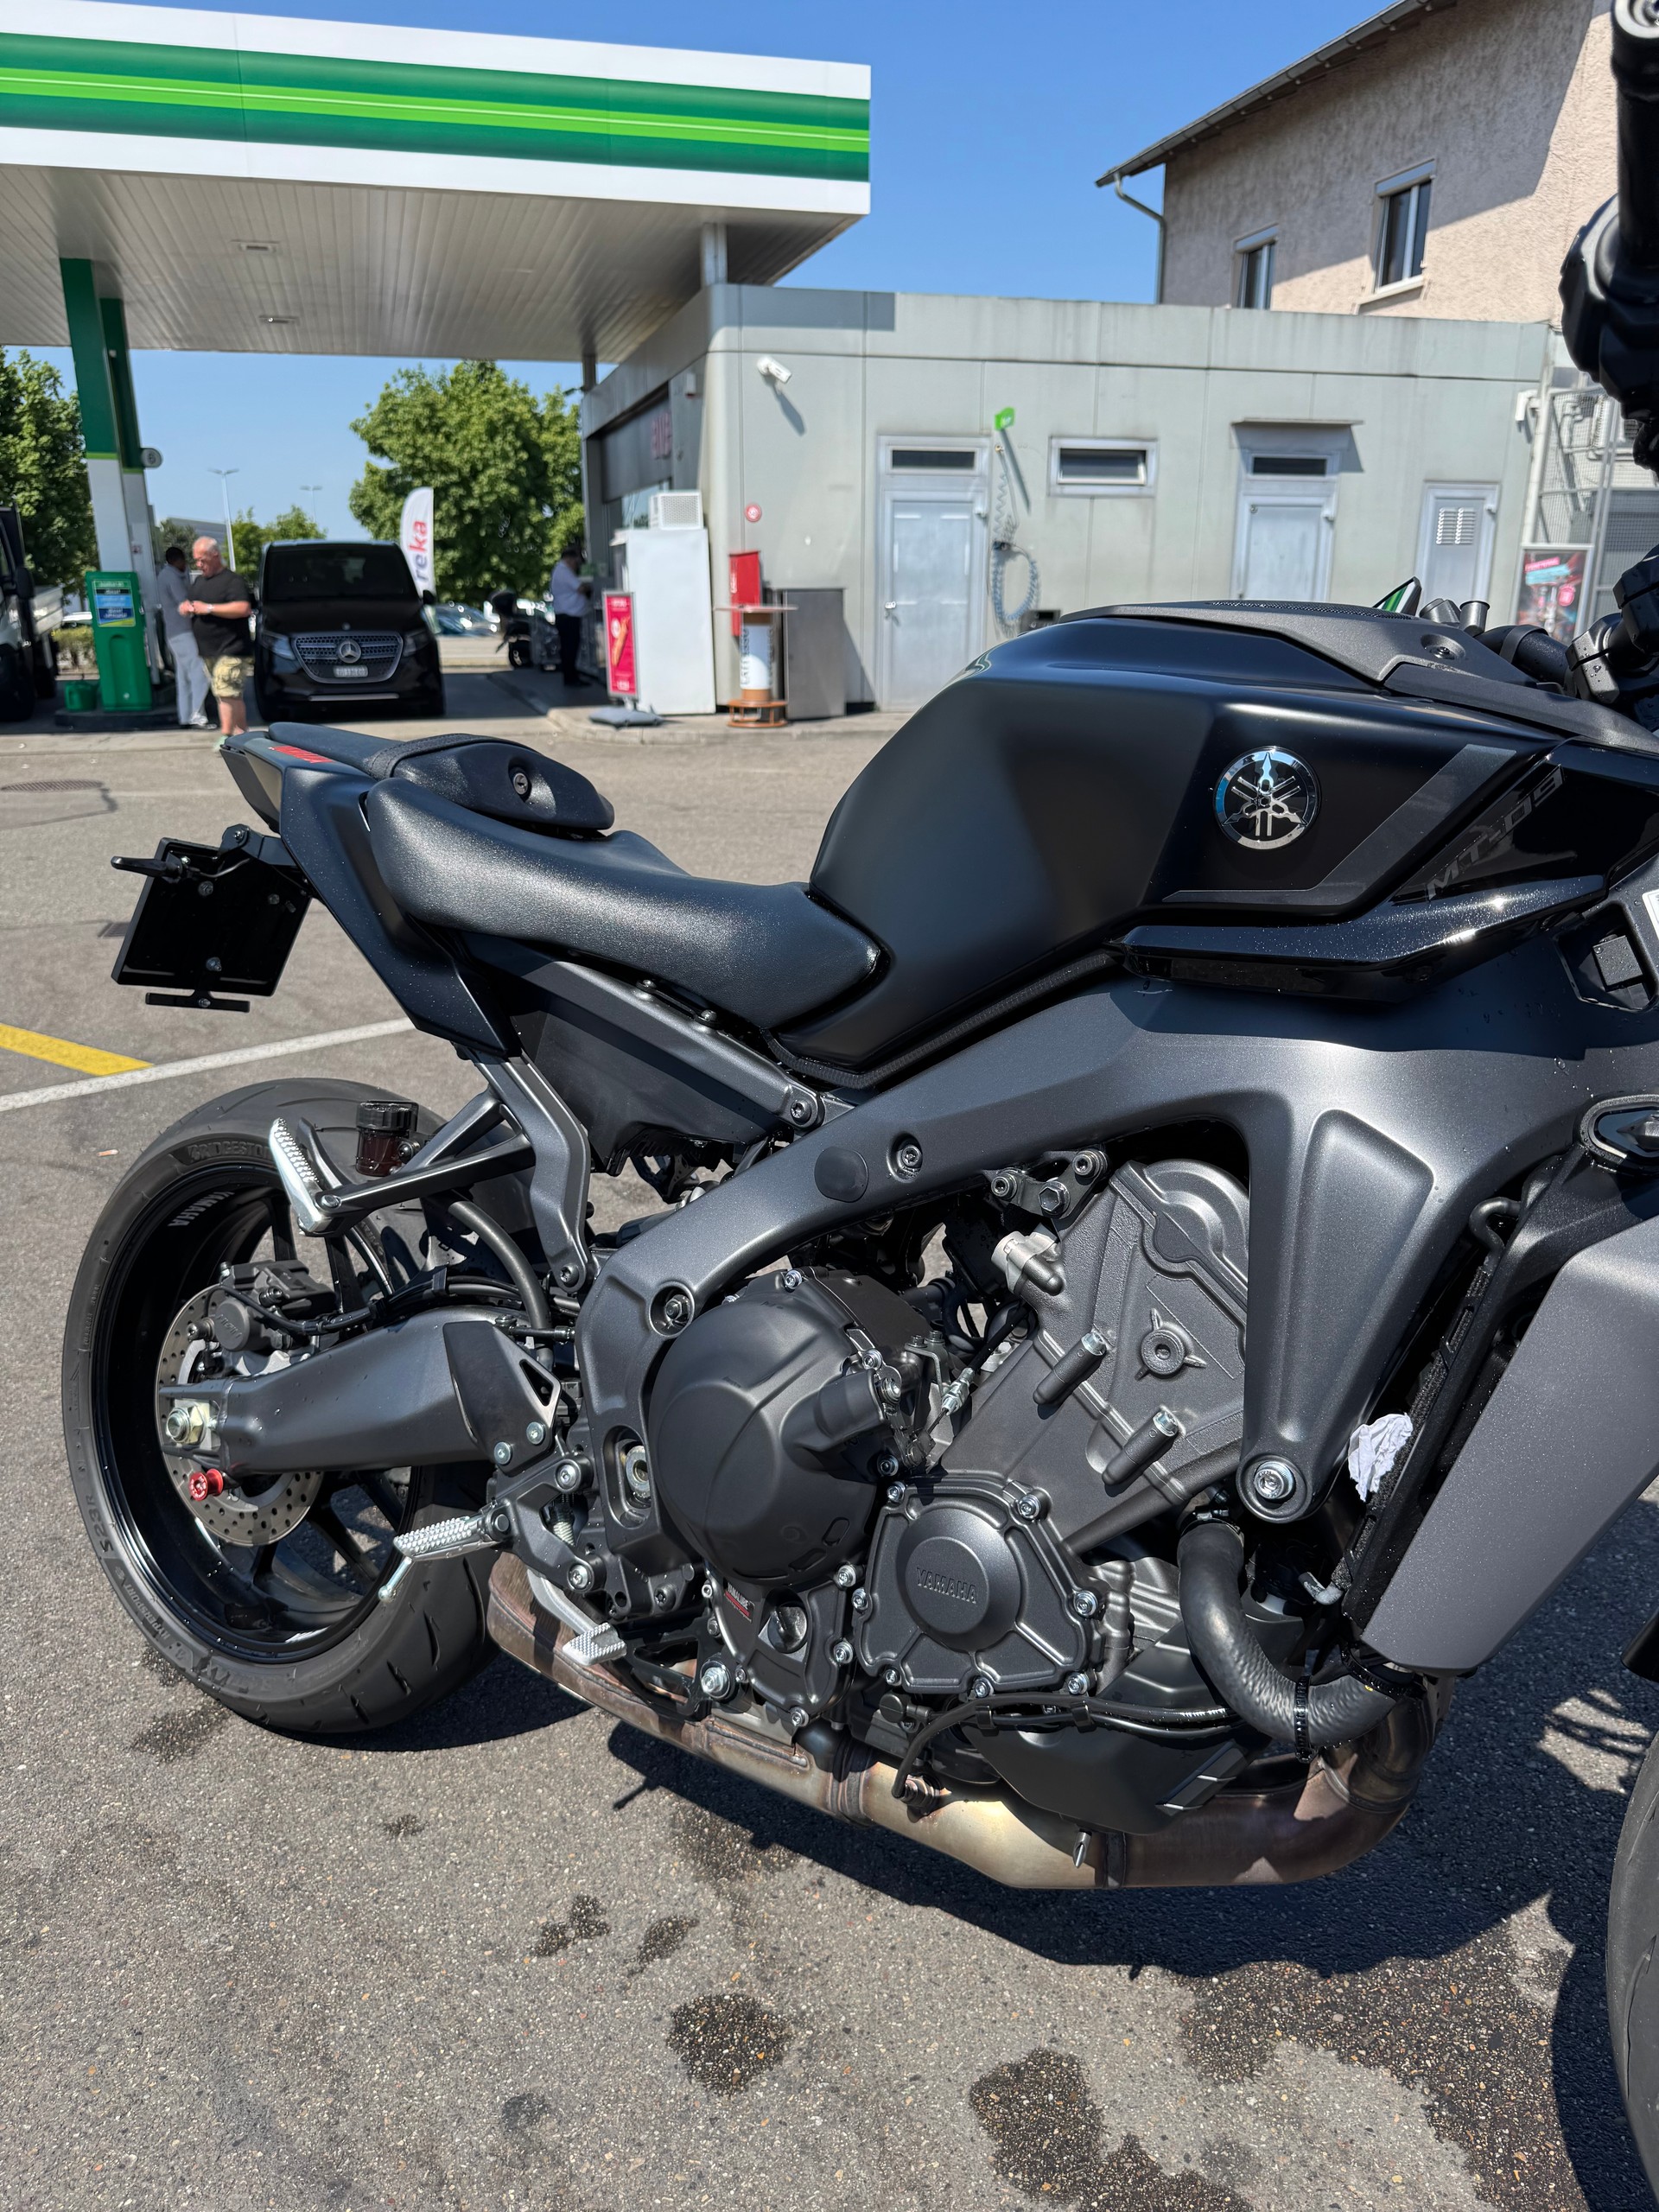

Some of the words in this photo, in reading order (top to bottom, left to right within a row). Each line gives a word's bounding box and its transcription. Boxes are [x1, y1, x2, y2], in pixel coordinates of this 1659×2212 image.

[410, 521, 428, 582] reka
[1427, 765, 1564, 900] MT-09
[188, 1141, 272, 1160] BRIDGESTON
[168, 1192, 235, 1226] YAMAHA
[917, 1567, 976, 1605] YAMAHA
